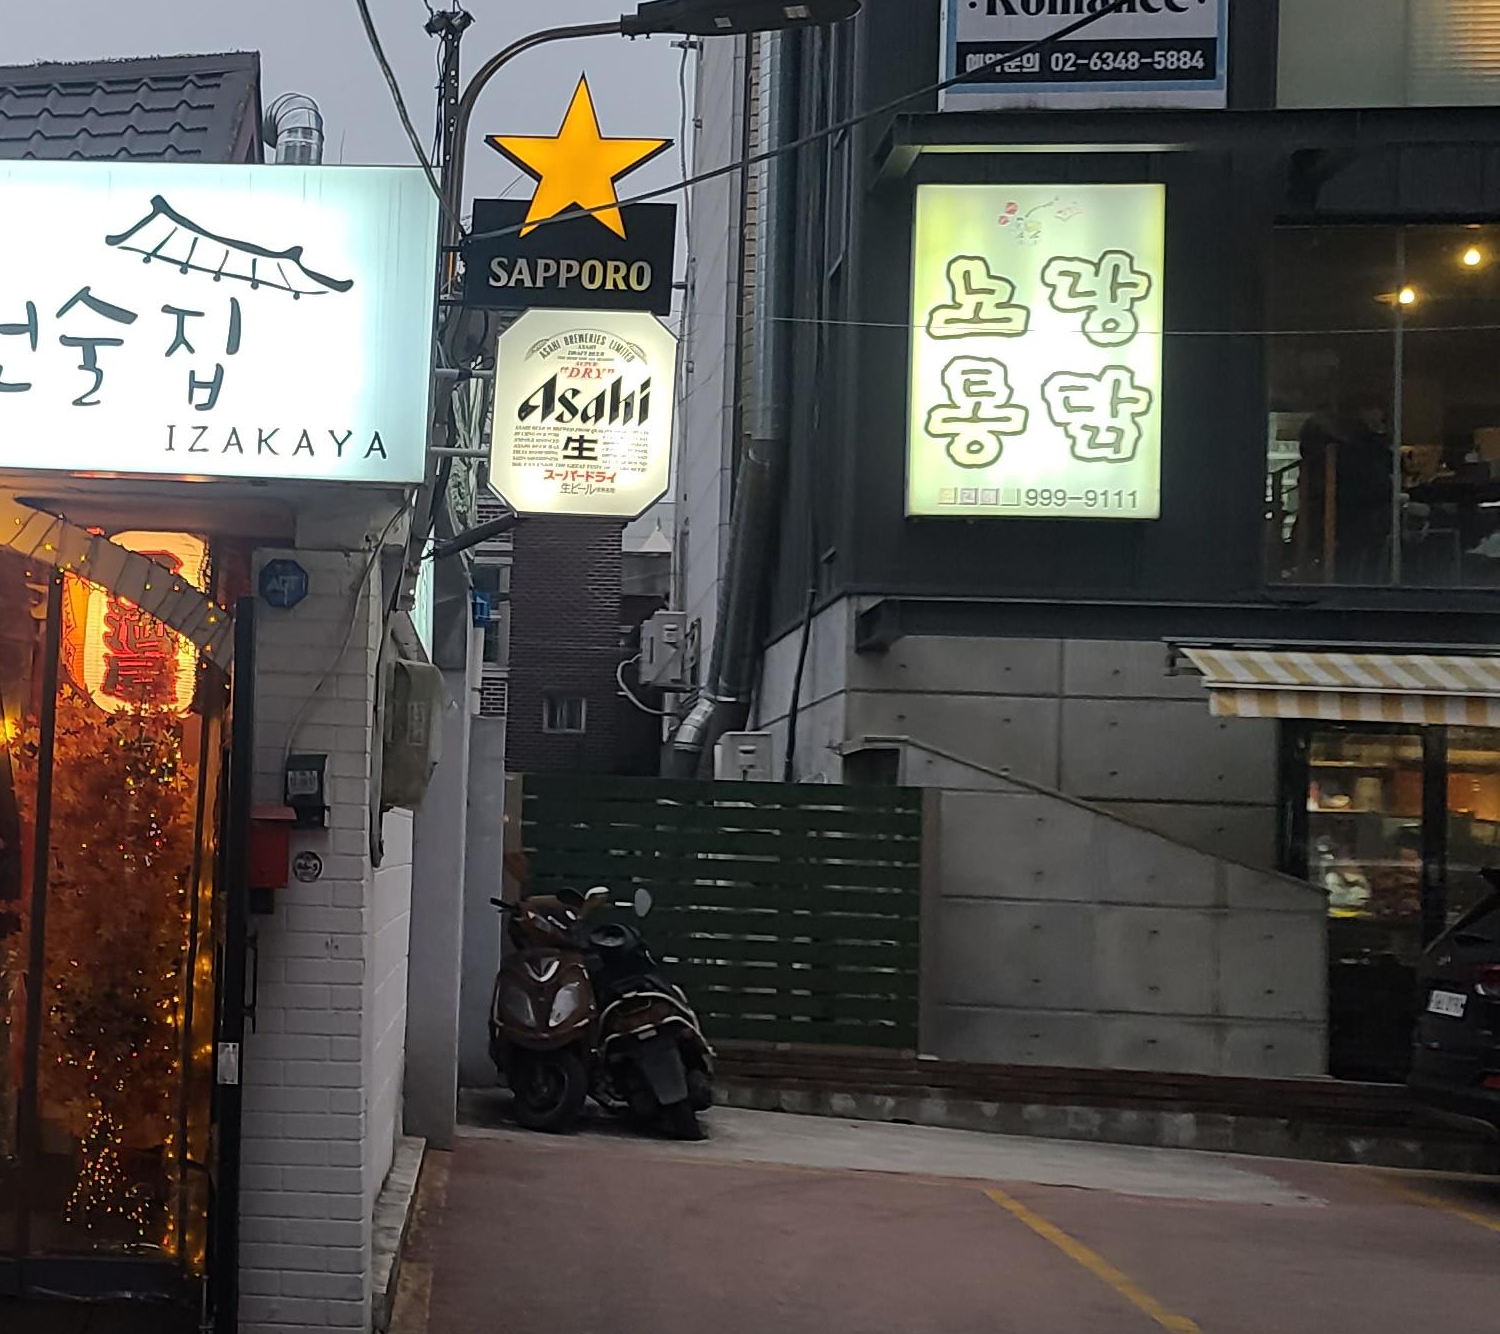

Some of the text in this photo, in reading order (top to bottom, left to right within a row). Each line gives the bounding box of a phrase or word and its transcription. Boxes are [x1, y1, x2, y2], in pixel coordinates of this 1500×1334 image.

[1050, 50, 1206, 72] 02-6348-5884
[488, 257, 653, 292] SAPPORO
[926, 249, 1152, 348] 노랑
[517, 372, 652, 426] Asahi
[925, 354, 1152, 469] 통닭
[166, 423, 389, 461] IZAKAYA
[561, 434, 598, 461] 生
[543, 469, 617, 483] スーパードライ
[1024, 488, 1139, 509] 999-9111
